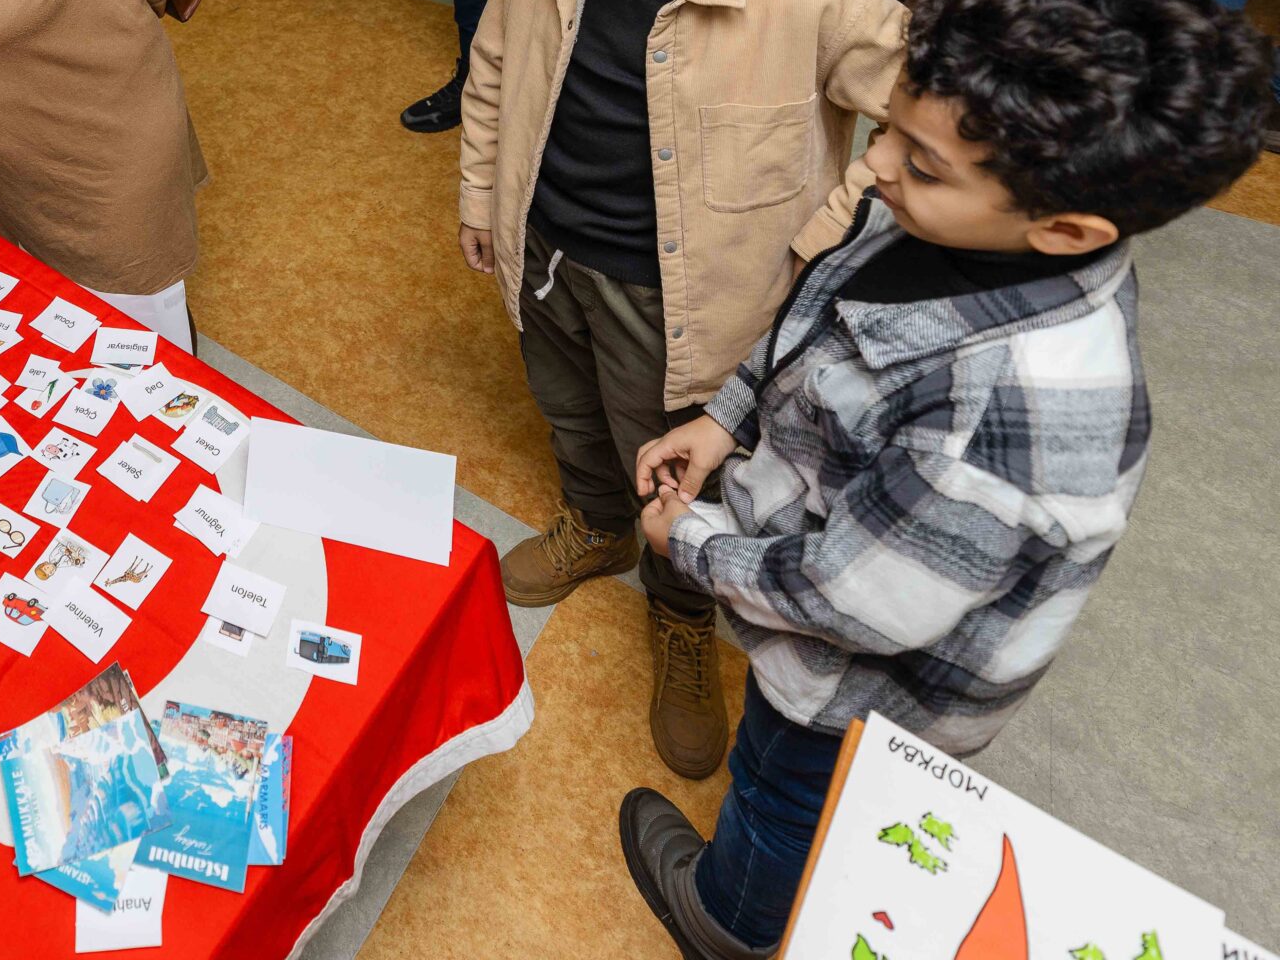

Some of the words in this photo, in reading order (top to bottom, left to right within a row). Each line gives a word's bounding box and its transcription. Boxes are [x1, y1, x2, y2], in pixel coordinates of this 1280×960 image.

[53, 312, 76, 329] Çocuk
[106, 341, 149, 353] Bilgisayar
[28, 367, 47, 379] Lale
[144, 380, 164, 396] Dağ
[73, 404, 97, 420] Çiçek
[195, 436, 221, 457] Ceket
[117, 459, 142, 480] Şeker
[194, 506, 226, 538] Yağmur
[231, 584, 268, 609] Telefon
[64, 601, 104, 638] Veteriner
[888, 736, 988, 801] МОРКВА
[148, 845, 230, 882] Istanbul
[113, 897, 152, 912] Anah
